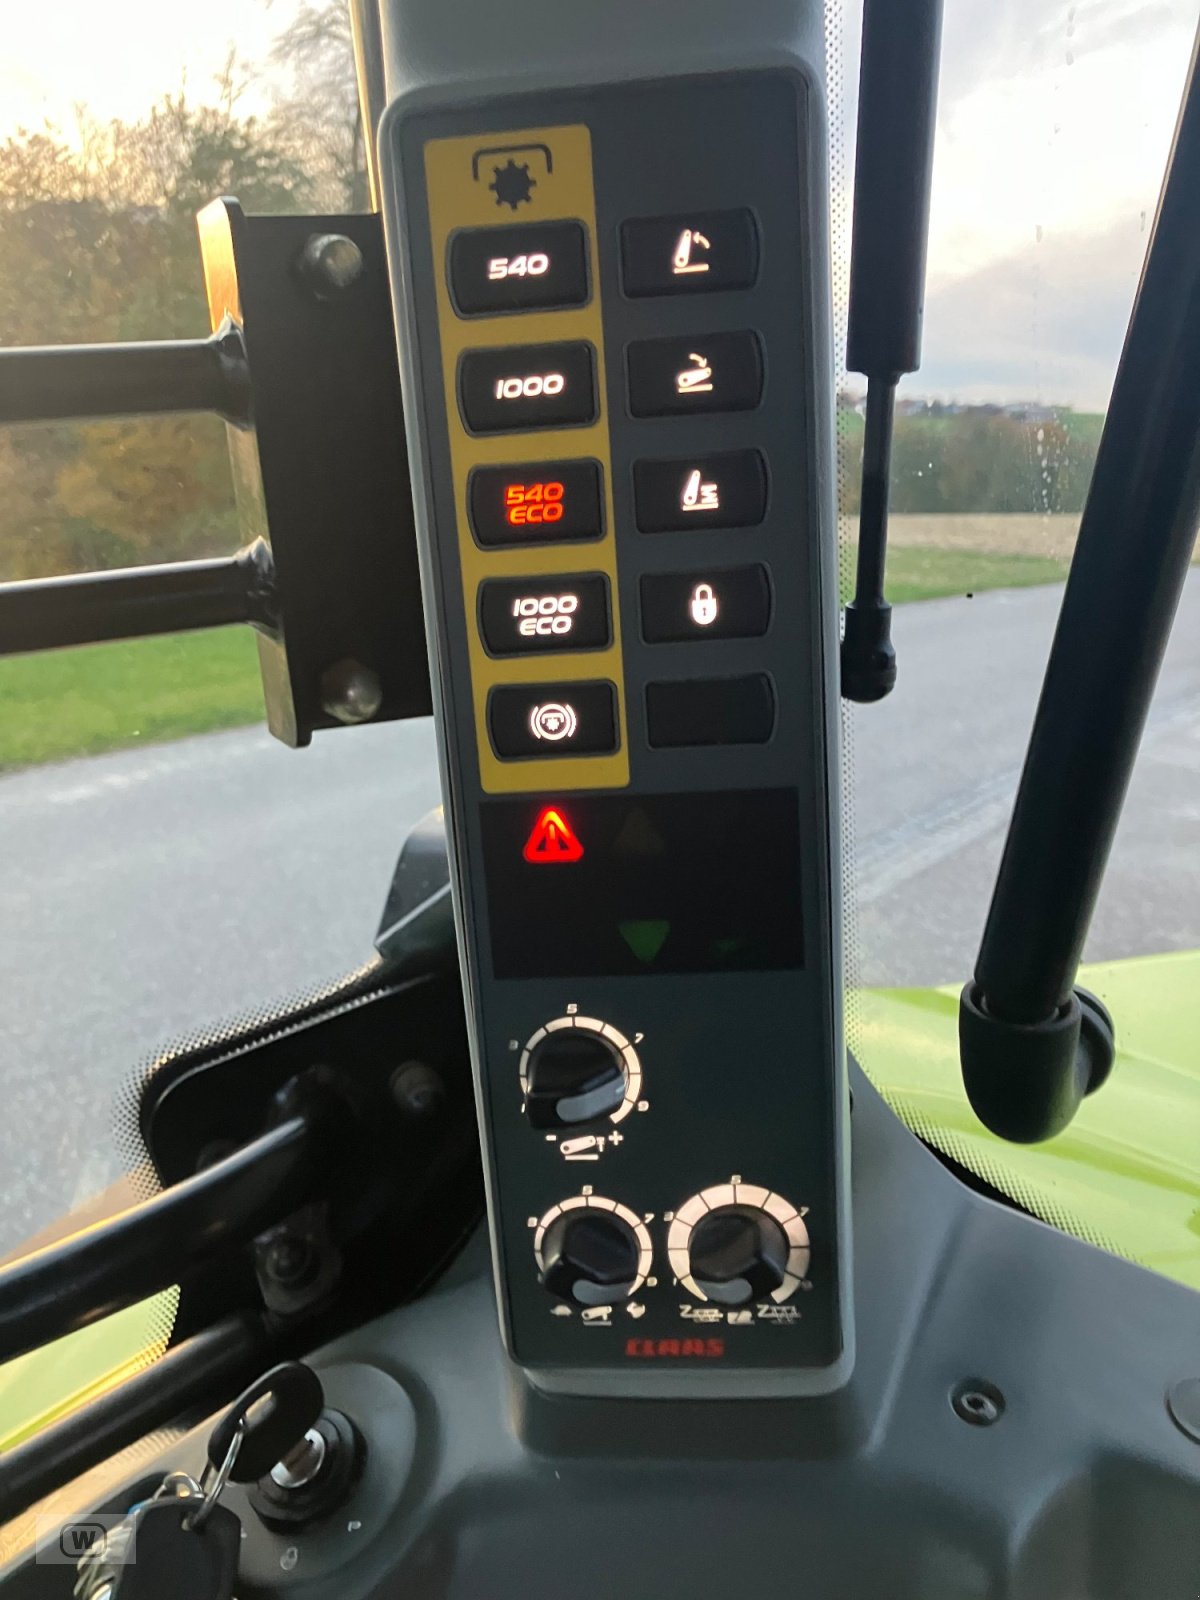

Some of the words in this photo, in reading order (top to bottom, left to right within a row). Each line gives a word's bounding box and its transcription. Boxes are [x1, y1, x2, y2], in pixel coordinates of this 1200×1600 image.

[488, 253, 550, 281] 540
[495, 373, 565, 400] 1000
[506, 482, 565, 505] 540
[508, 502, 565, 525] ECO
[512, 595, 579, 617] 1000
[518, 615, 573, 637] ECO
[566, 1003, 578, 1014] 5
[634, 1032, 645, 1044] 7
[644, 1212, 655, 1224] 7
